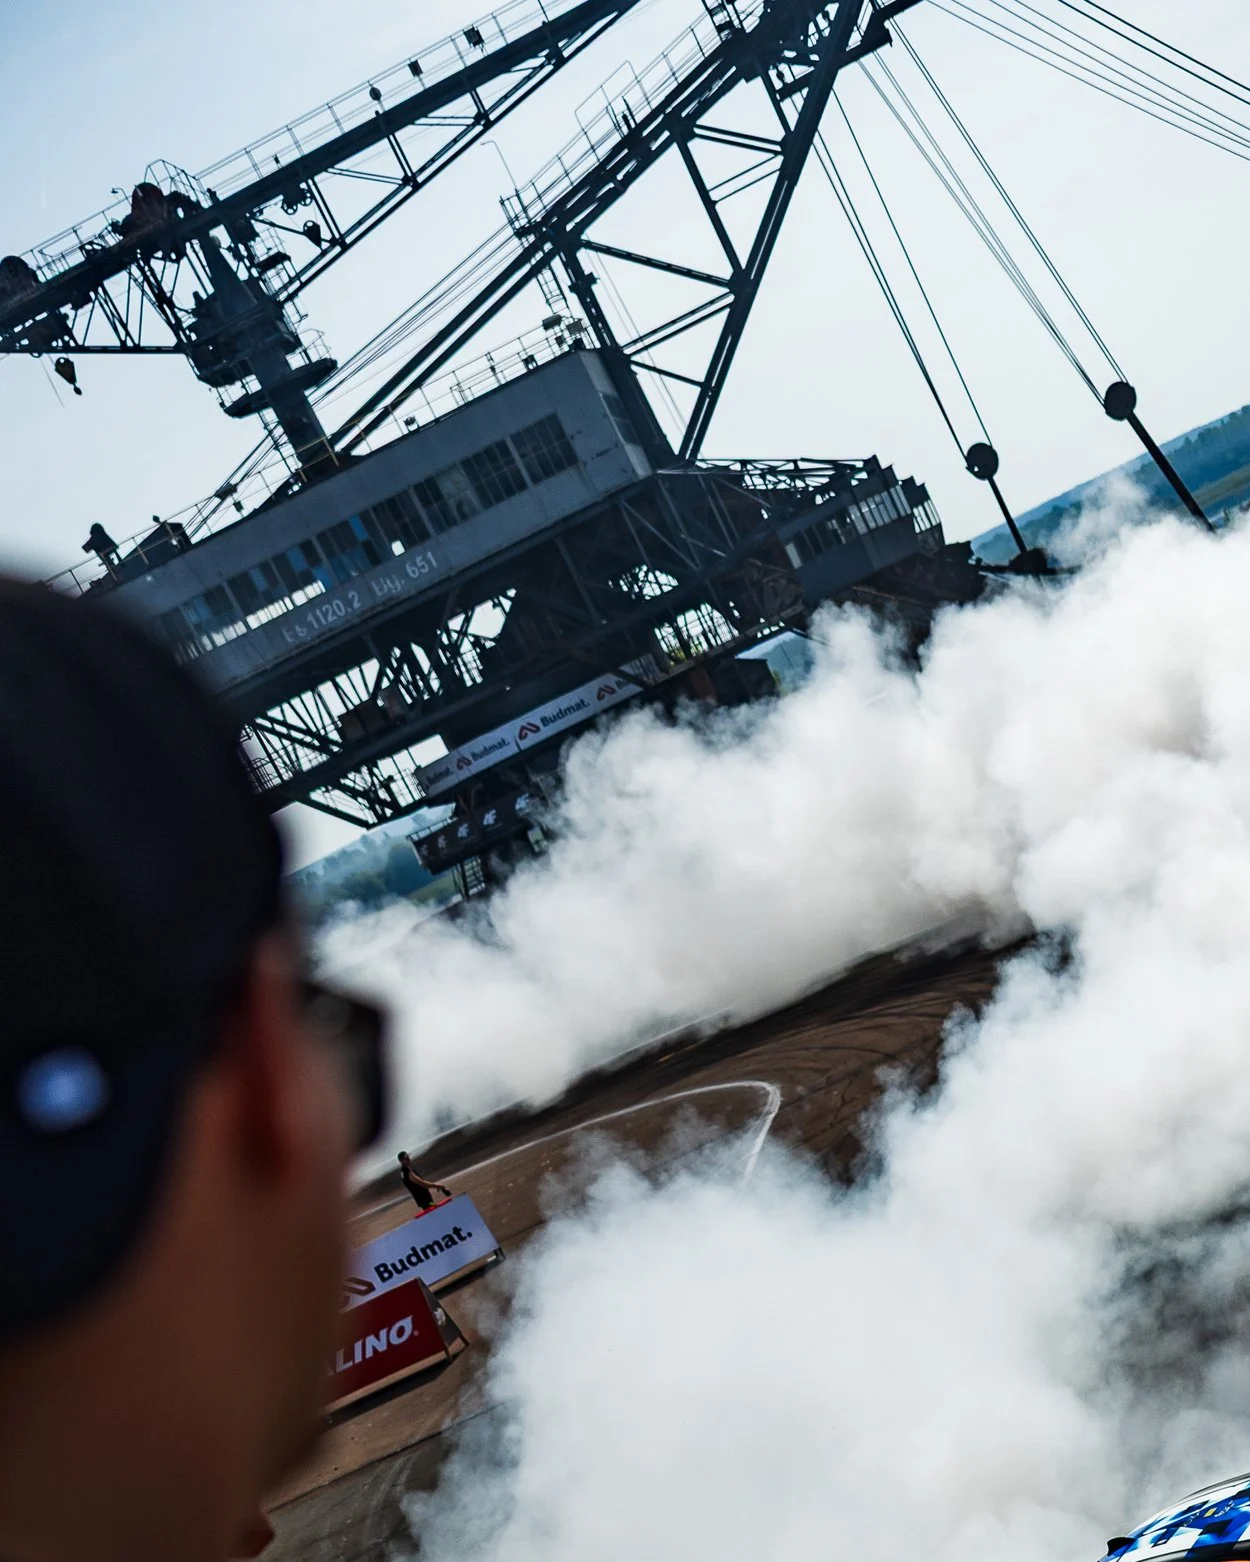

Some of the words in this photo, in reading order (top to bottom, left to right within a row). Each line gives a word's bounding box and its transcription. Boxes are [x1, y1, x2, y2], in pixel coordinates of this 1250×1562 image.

[405, 550, 439, 579] 651
[540, 698, 590, 728] Budmat.
[373, 1223, 473, 1284] Budmat.
[334, 1314, 414, 1373] LINO
